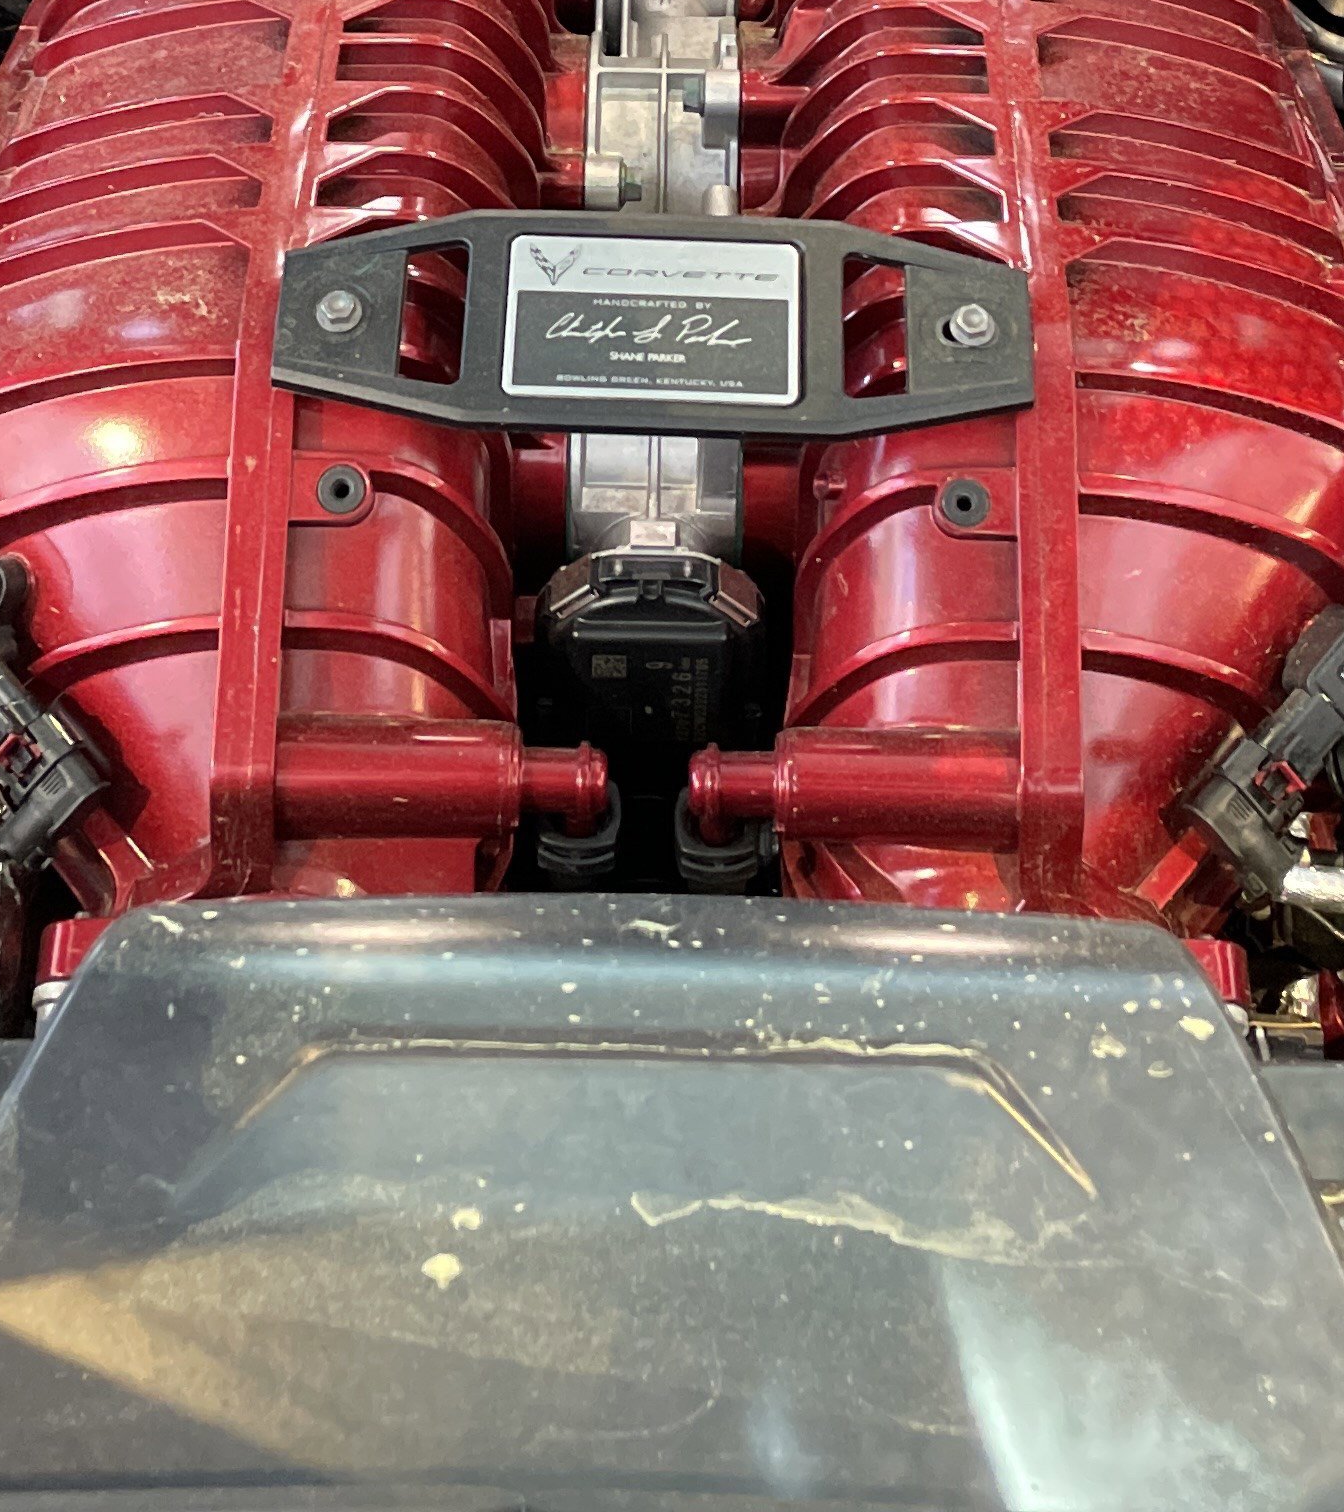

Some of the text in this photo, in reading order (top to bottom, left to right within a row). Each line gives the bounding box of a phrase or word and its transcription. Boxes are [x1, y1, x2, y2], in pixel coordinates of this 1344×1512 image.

[582, 267, 779, 282] CORVETTE
[593, 298, 712, 310] HANDCRAFTED BY
[609, 350, 687, 364] SHANE PARKER
[556, 374, 744, 388] BOWLING GREEN, KENTUCKY, USA
